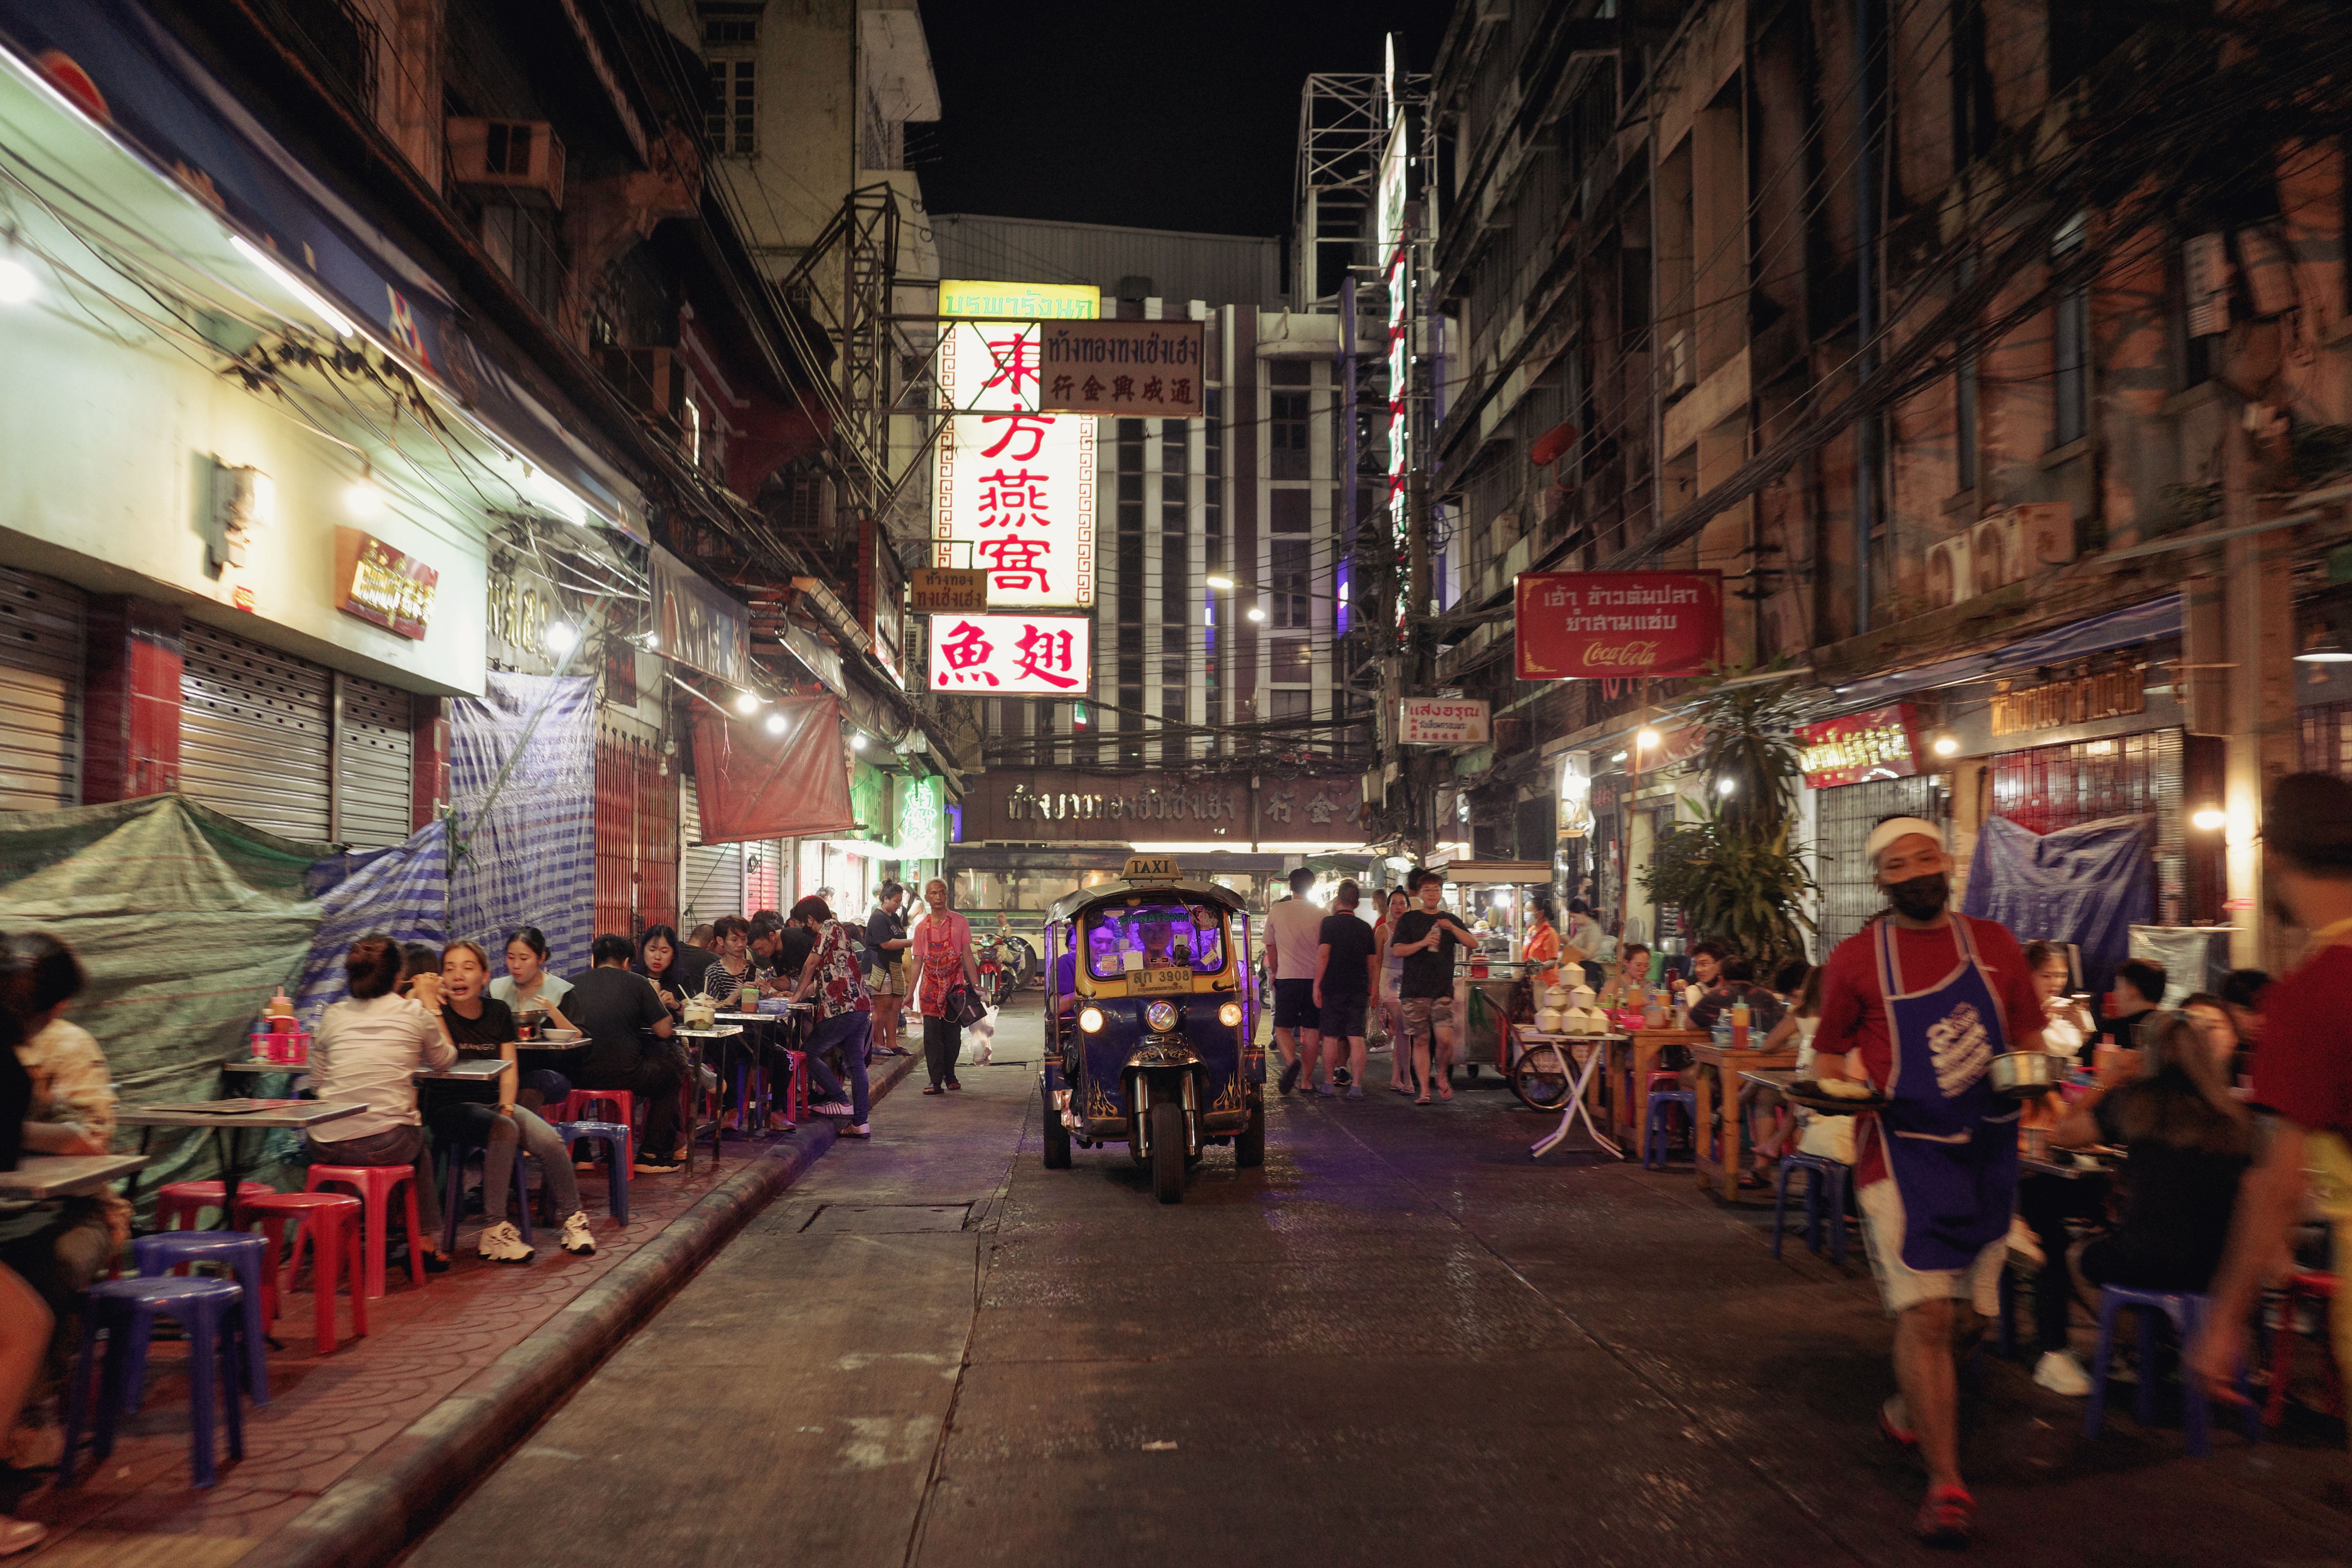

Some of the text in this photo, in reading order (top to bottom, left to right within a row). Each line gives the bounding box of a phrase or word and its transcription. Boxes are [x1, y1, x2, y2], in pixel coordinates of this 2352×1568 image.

[978, 332, 1055, 593] 東方燕窩
[926, 571, 973, 585] ห้างทอง
[1588, 584, 1698, 605] ข้าวต้มปลา
[938, 620, 1079, 689] 魚翅
[1410, 702, 1479, 720] แสงอรุณ
[1131, 860, 1170, 874] TAXI
[1118, 913, 1189, 925] CHINATOWN
[1159, 970, 1190, 982] 3908
